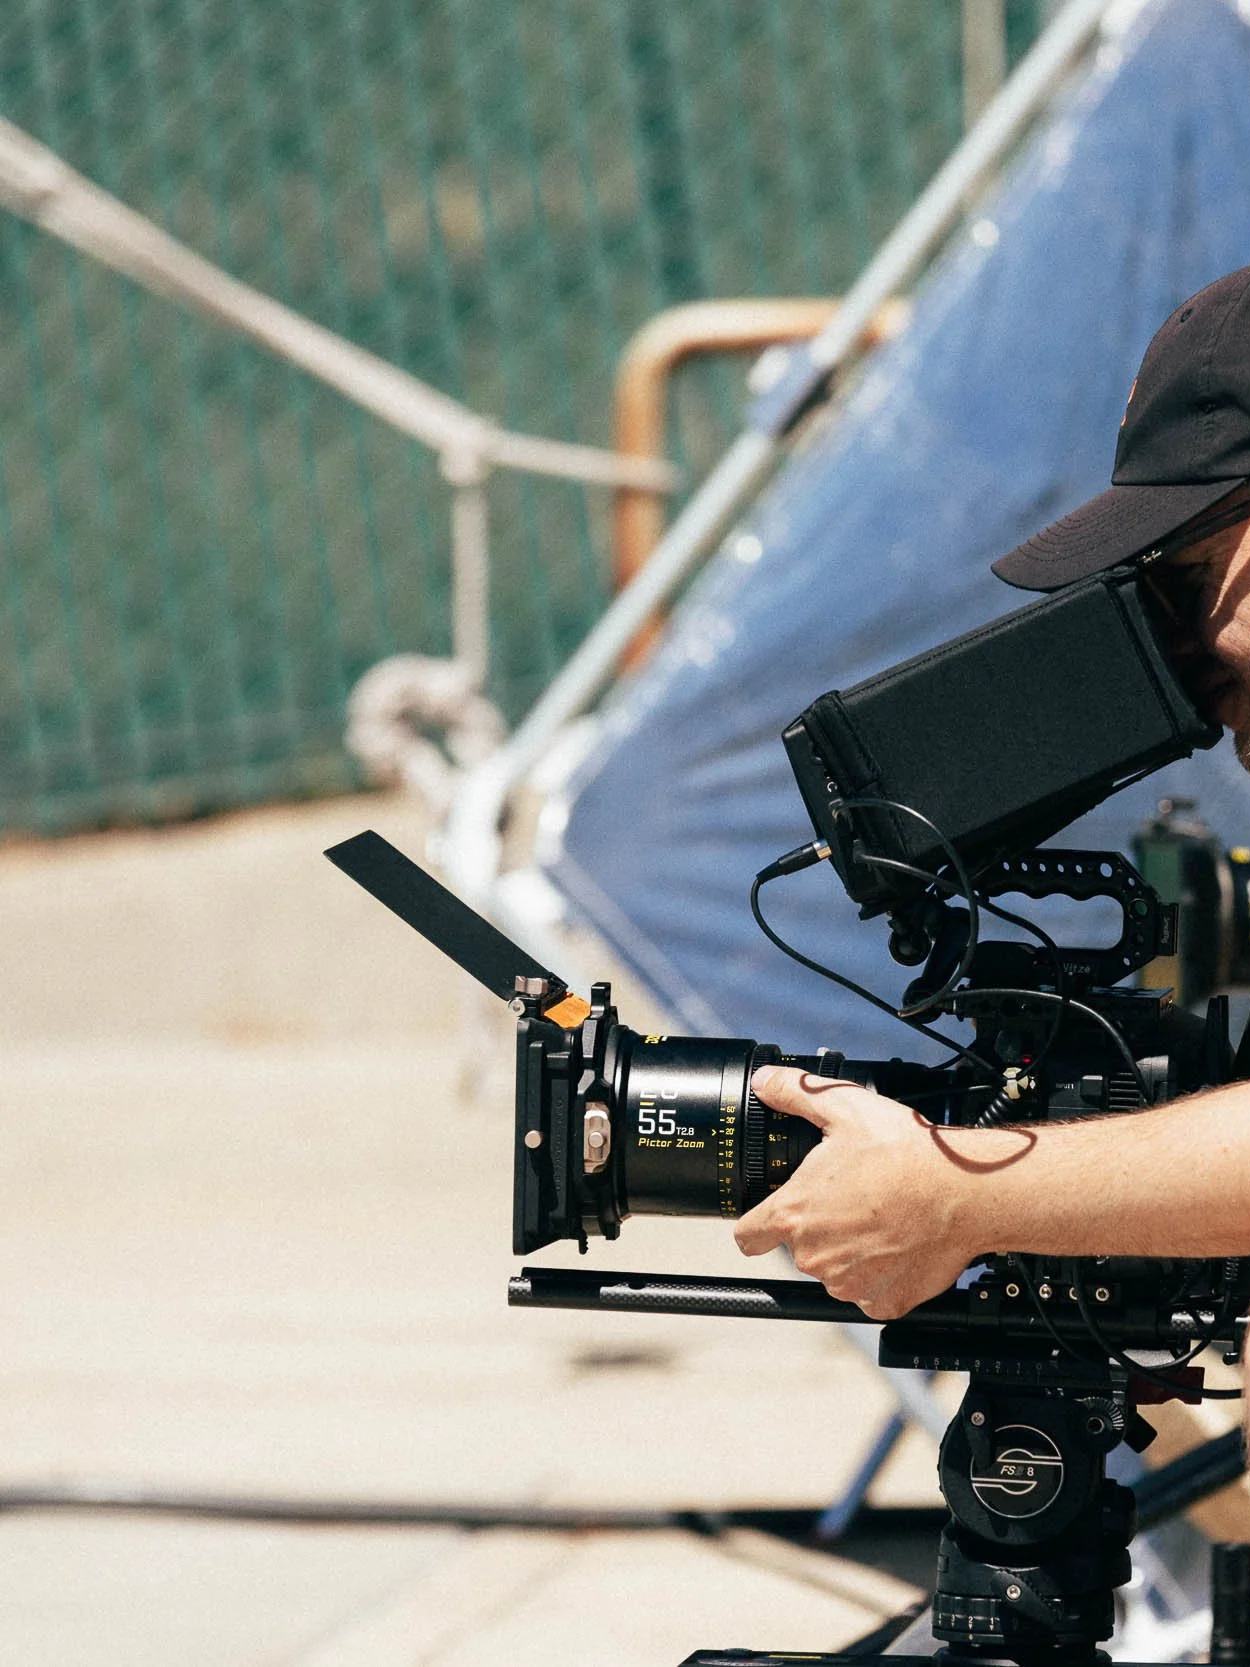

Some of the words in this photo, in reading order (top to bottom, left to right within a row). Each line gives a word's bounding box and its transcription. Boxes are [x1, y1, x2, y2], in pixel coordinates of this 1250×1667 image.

[638, 1108, 677, 1135] 55
[676, 1127, 695, 1136] T2.8
[638, 1137, 673, 1148] Pictor
[676, 1138, 705, 1149] Zoom
[1027, 1466, 1034, 1477] 8
[968, 1615, 973, 1624] 2
